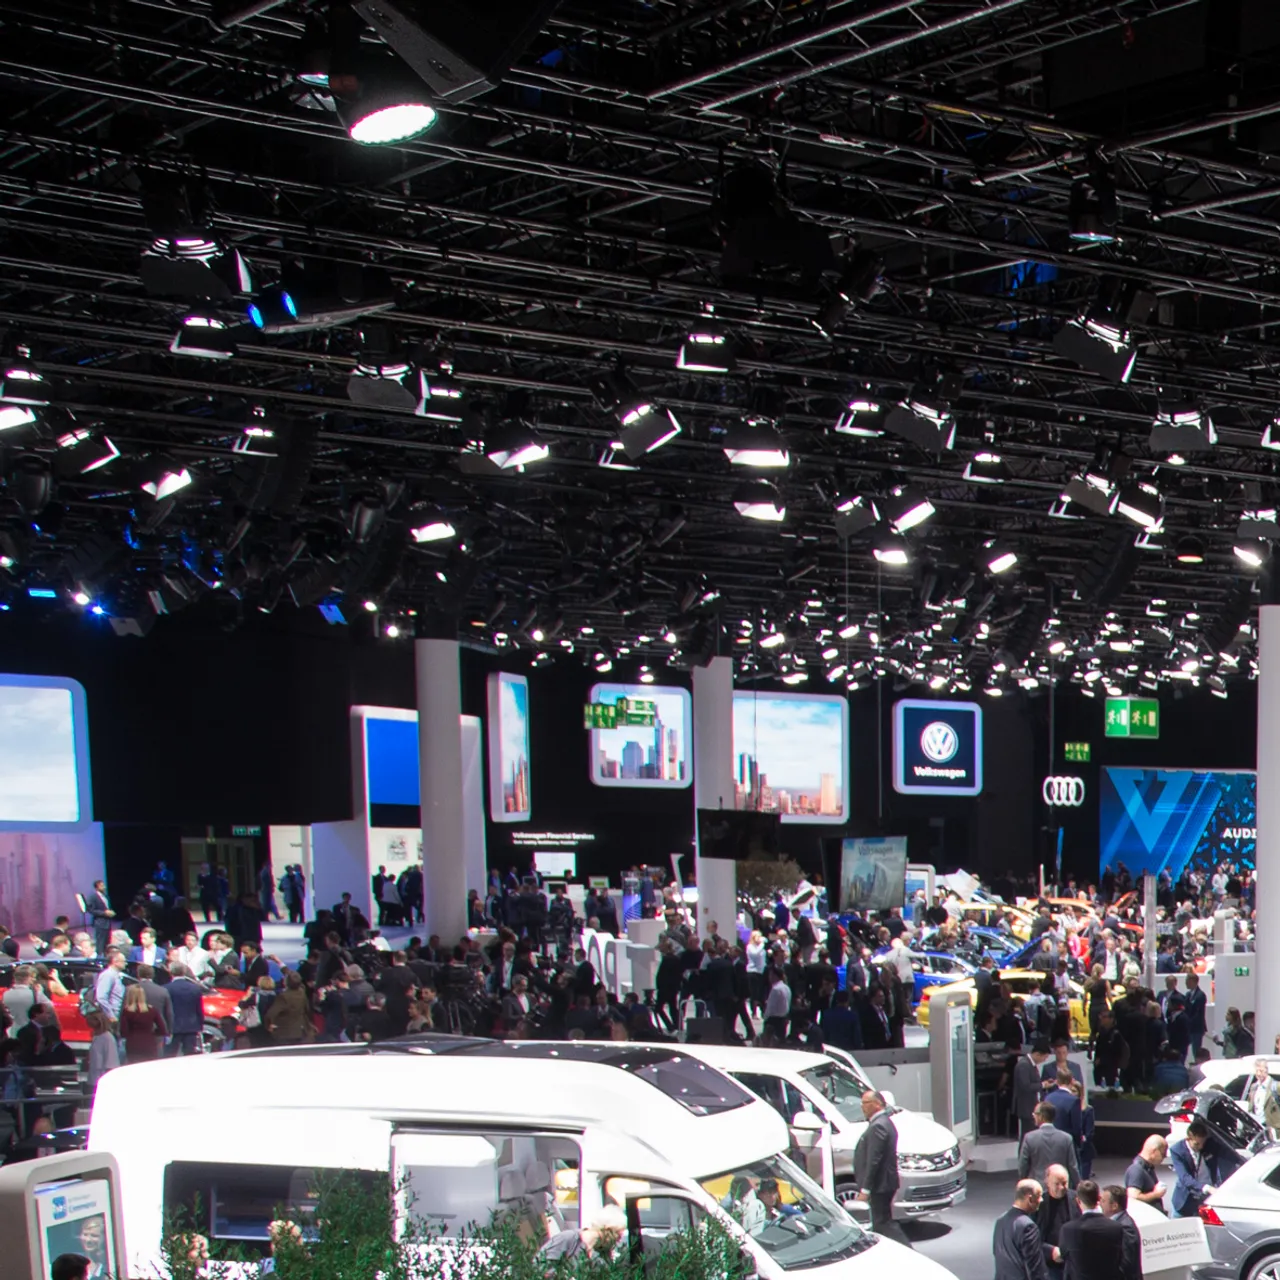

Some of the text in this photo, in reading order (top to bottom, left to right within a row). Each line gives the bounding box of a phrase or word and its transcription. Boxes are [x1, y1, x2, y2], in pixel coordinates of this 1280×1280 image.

[913, 765, 967, 780] Volkswagen
[1222, 827, 1257, 839] AUDI
[1142, 1237, 1165, 1247] Driver
